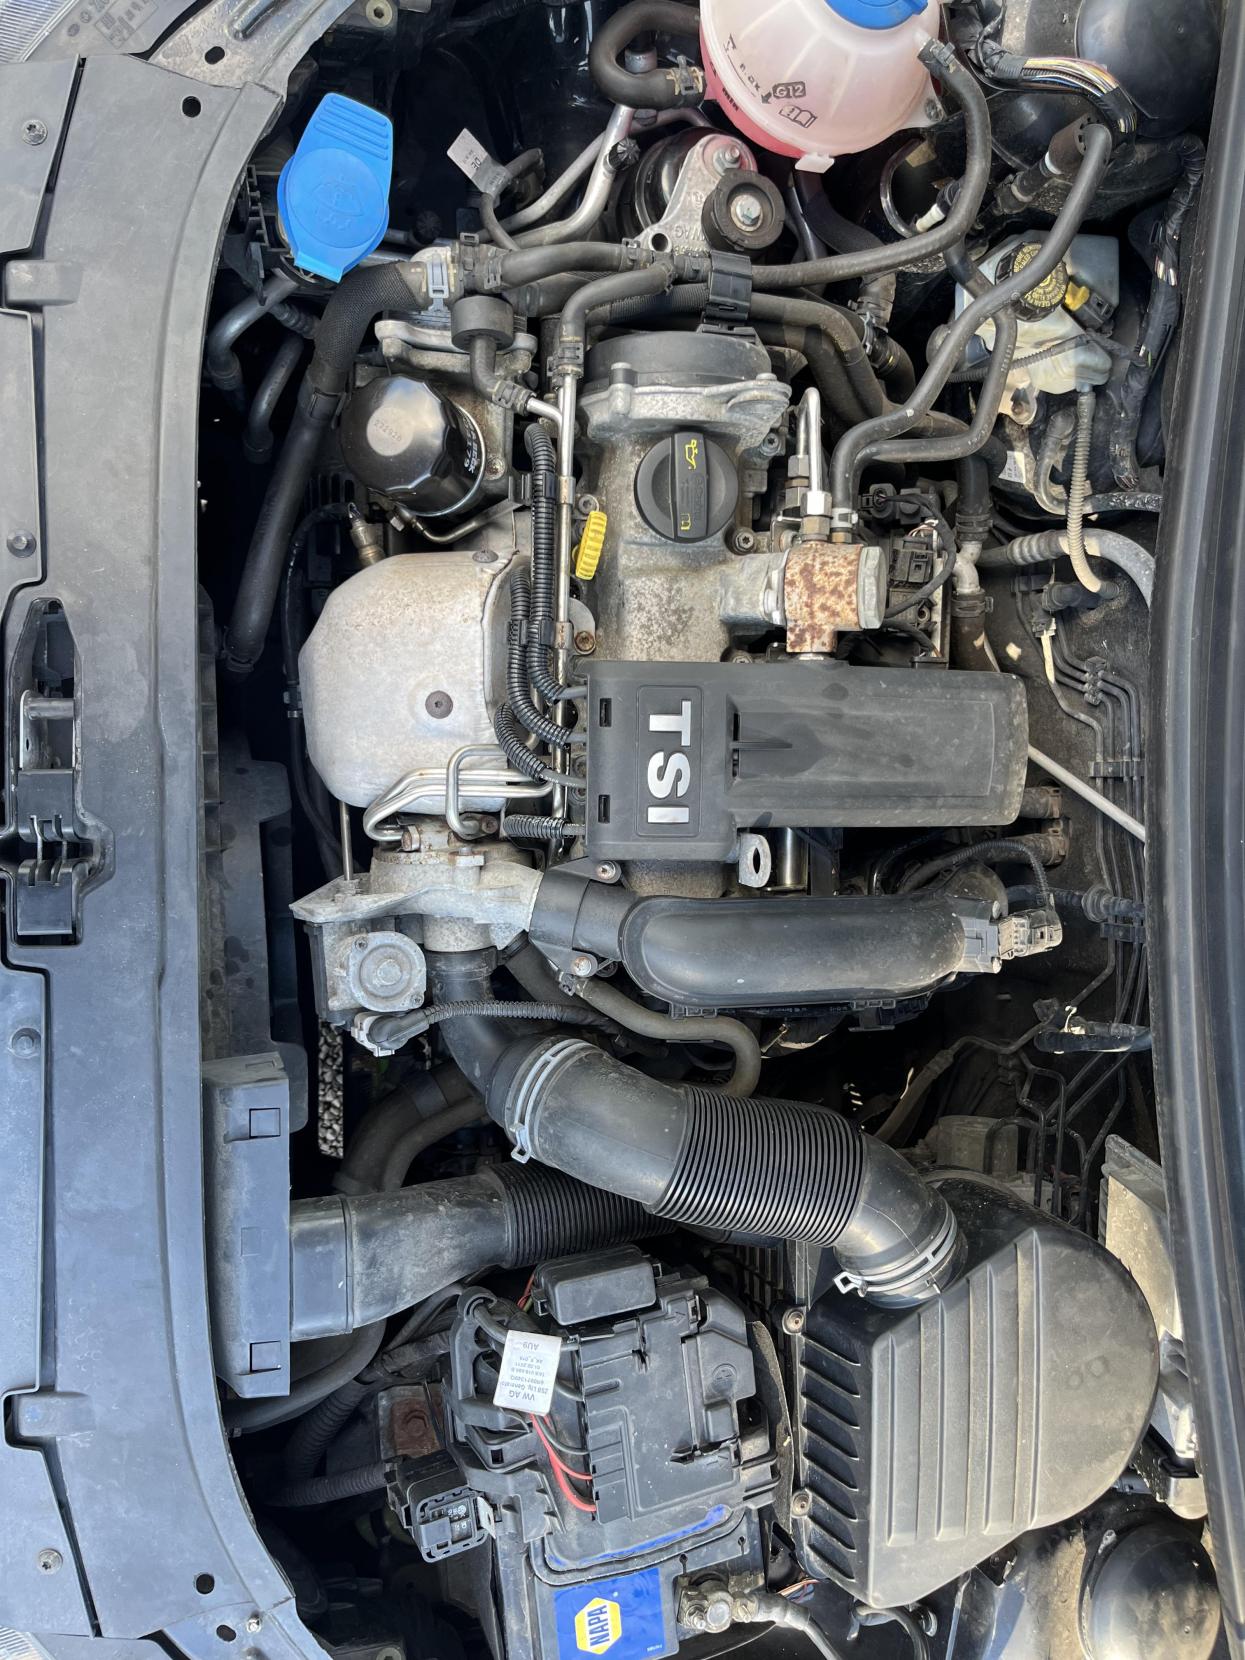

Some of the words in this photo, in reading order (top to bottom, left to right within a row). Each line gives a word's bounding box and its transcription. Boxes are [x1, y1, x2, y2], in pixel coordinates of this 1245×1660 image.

[776, 84, 805, 98] G12
[647, 700, 692, 823] TSI
[508, 1390, 521, 1398] AG
[523, 1393, 535, 1401] VW
[587, 1604, 610, 1647] NAPA
